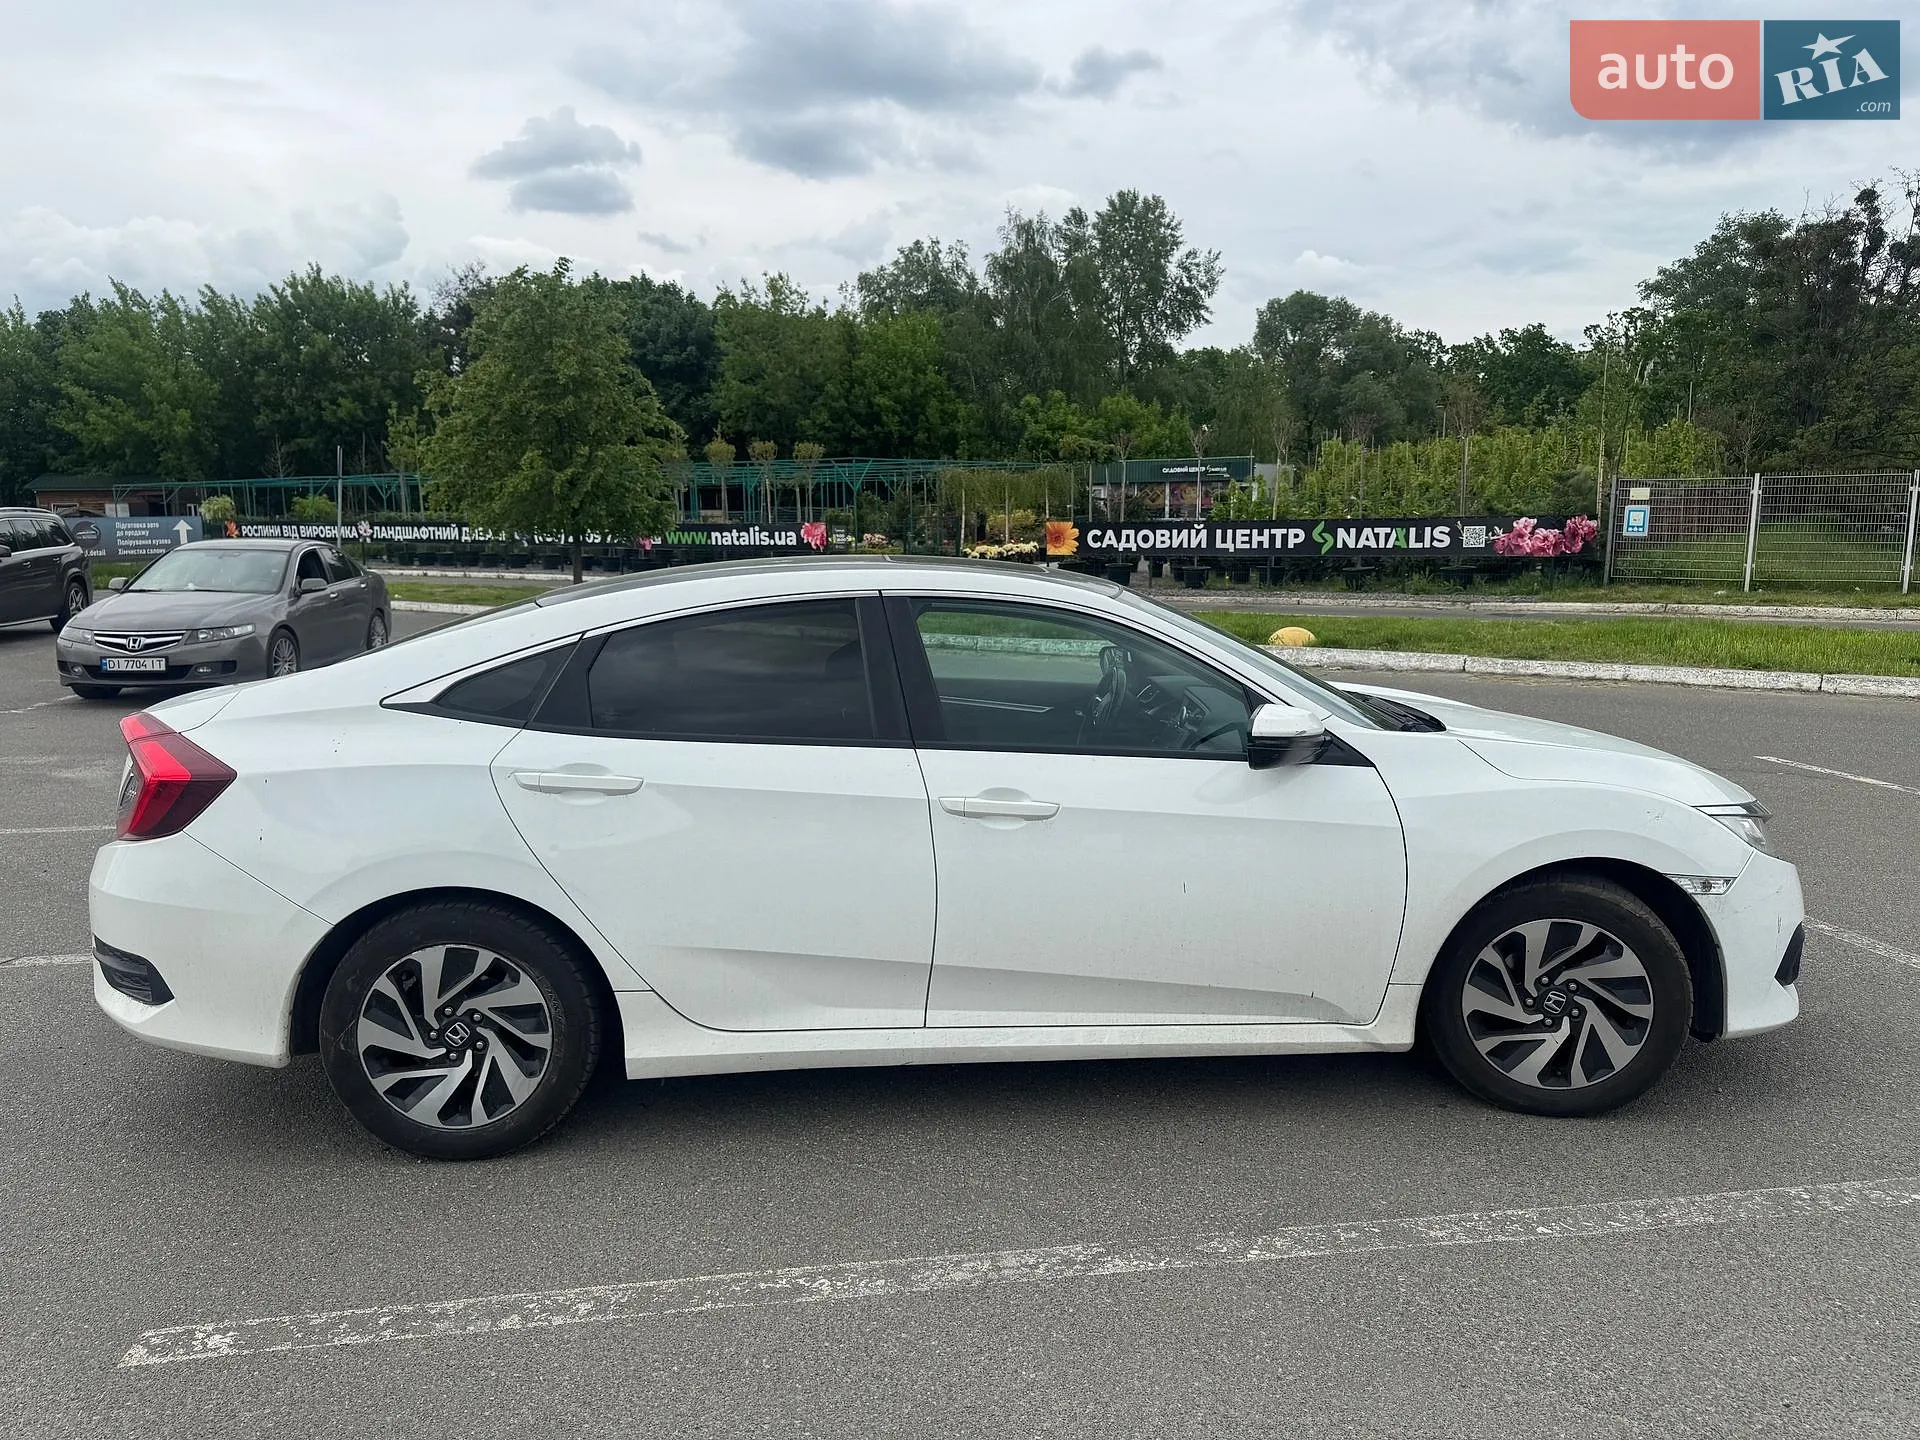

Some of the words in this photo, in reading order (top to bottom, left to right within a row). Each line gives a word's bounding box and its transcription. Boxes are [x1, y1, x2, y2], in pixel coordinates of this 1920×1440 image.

[241, 525, 282, 537] РОСЛИНИ
[282, 525, 299, 540] ВІД
[299, 525, 358, 539] ВИРОБНИКА
[373, 523, 459, 542] ЛАНДШАФТНИЙ
[665, 526, 797, 546] www.natalis.ua
[1086, 524, 1207, 552] САДОВИЙ
[1216, 528, 1305, 553] ЦЕНТР
[1336, 526, 1451, 549] NATALIS
[108, 659, 121, 669] DI
[124, 659, 147, 669] 7704
[151, 659, 163, 669] IT
